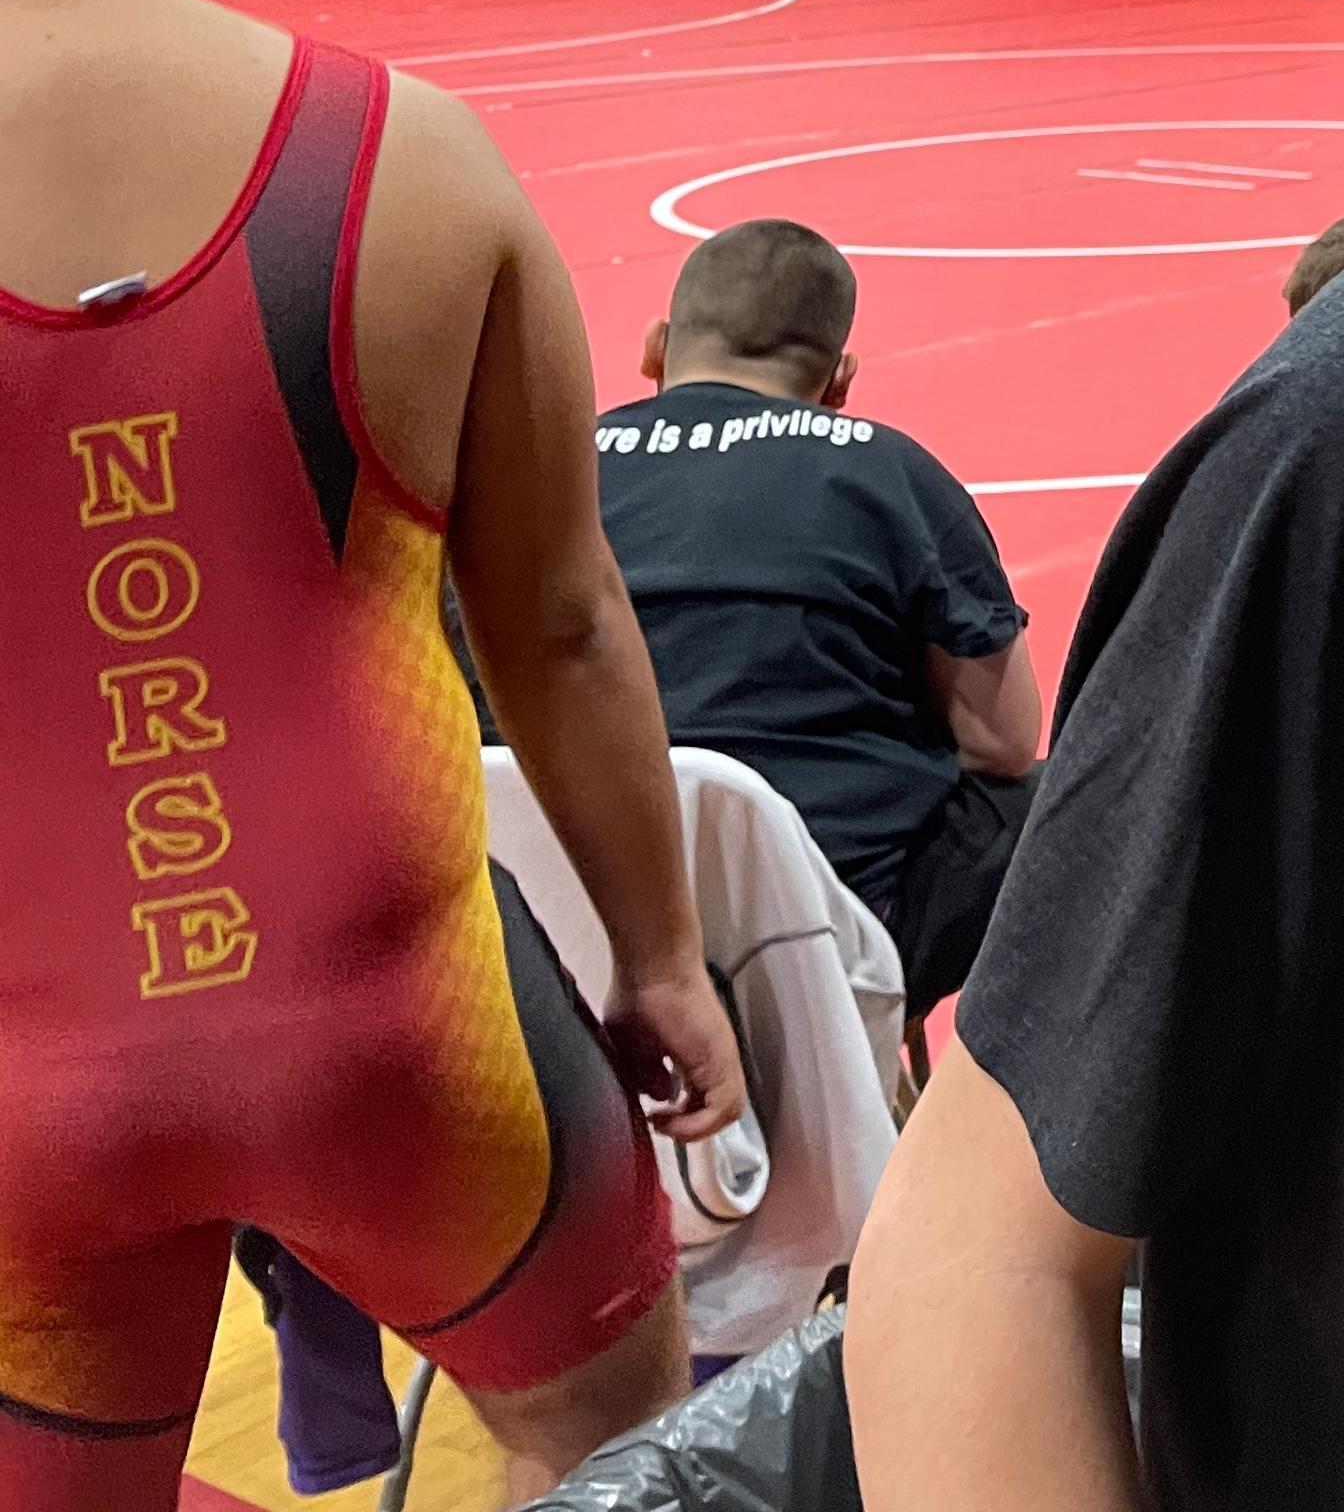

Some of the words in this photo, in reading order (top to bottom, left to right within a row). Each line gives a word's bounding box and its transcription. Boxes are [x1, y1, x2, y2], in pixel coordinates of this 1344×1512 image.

[595, 425, 641, 454] ve
[646, 418, 681, 454] is
[688, 421, 713, 450] a
[718, 409, 874, 453] privilege
[69, 410, 260, 1001] NORSE
